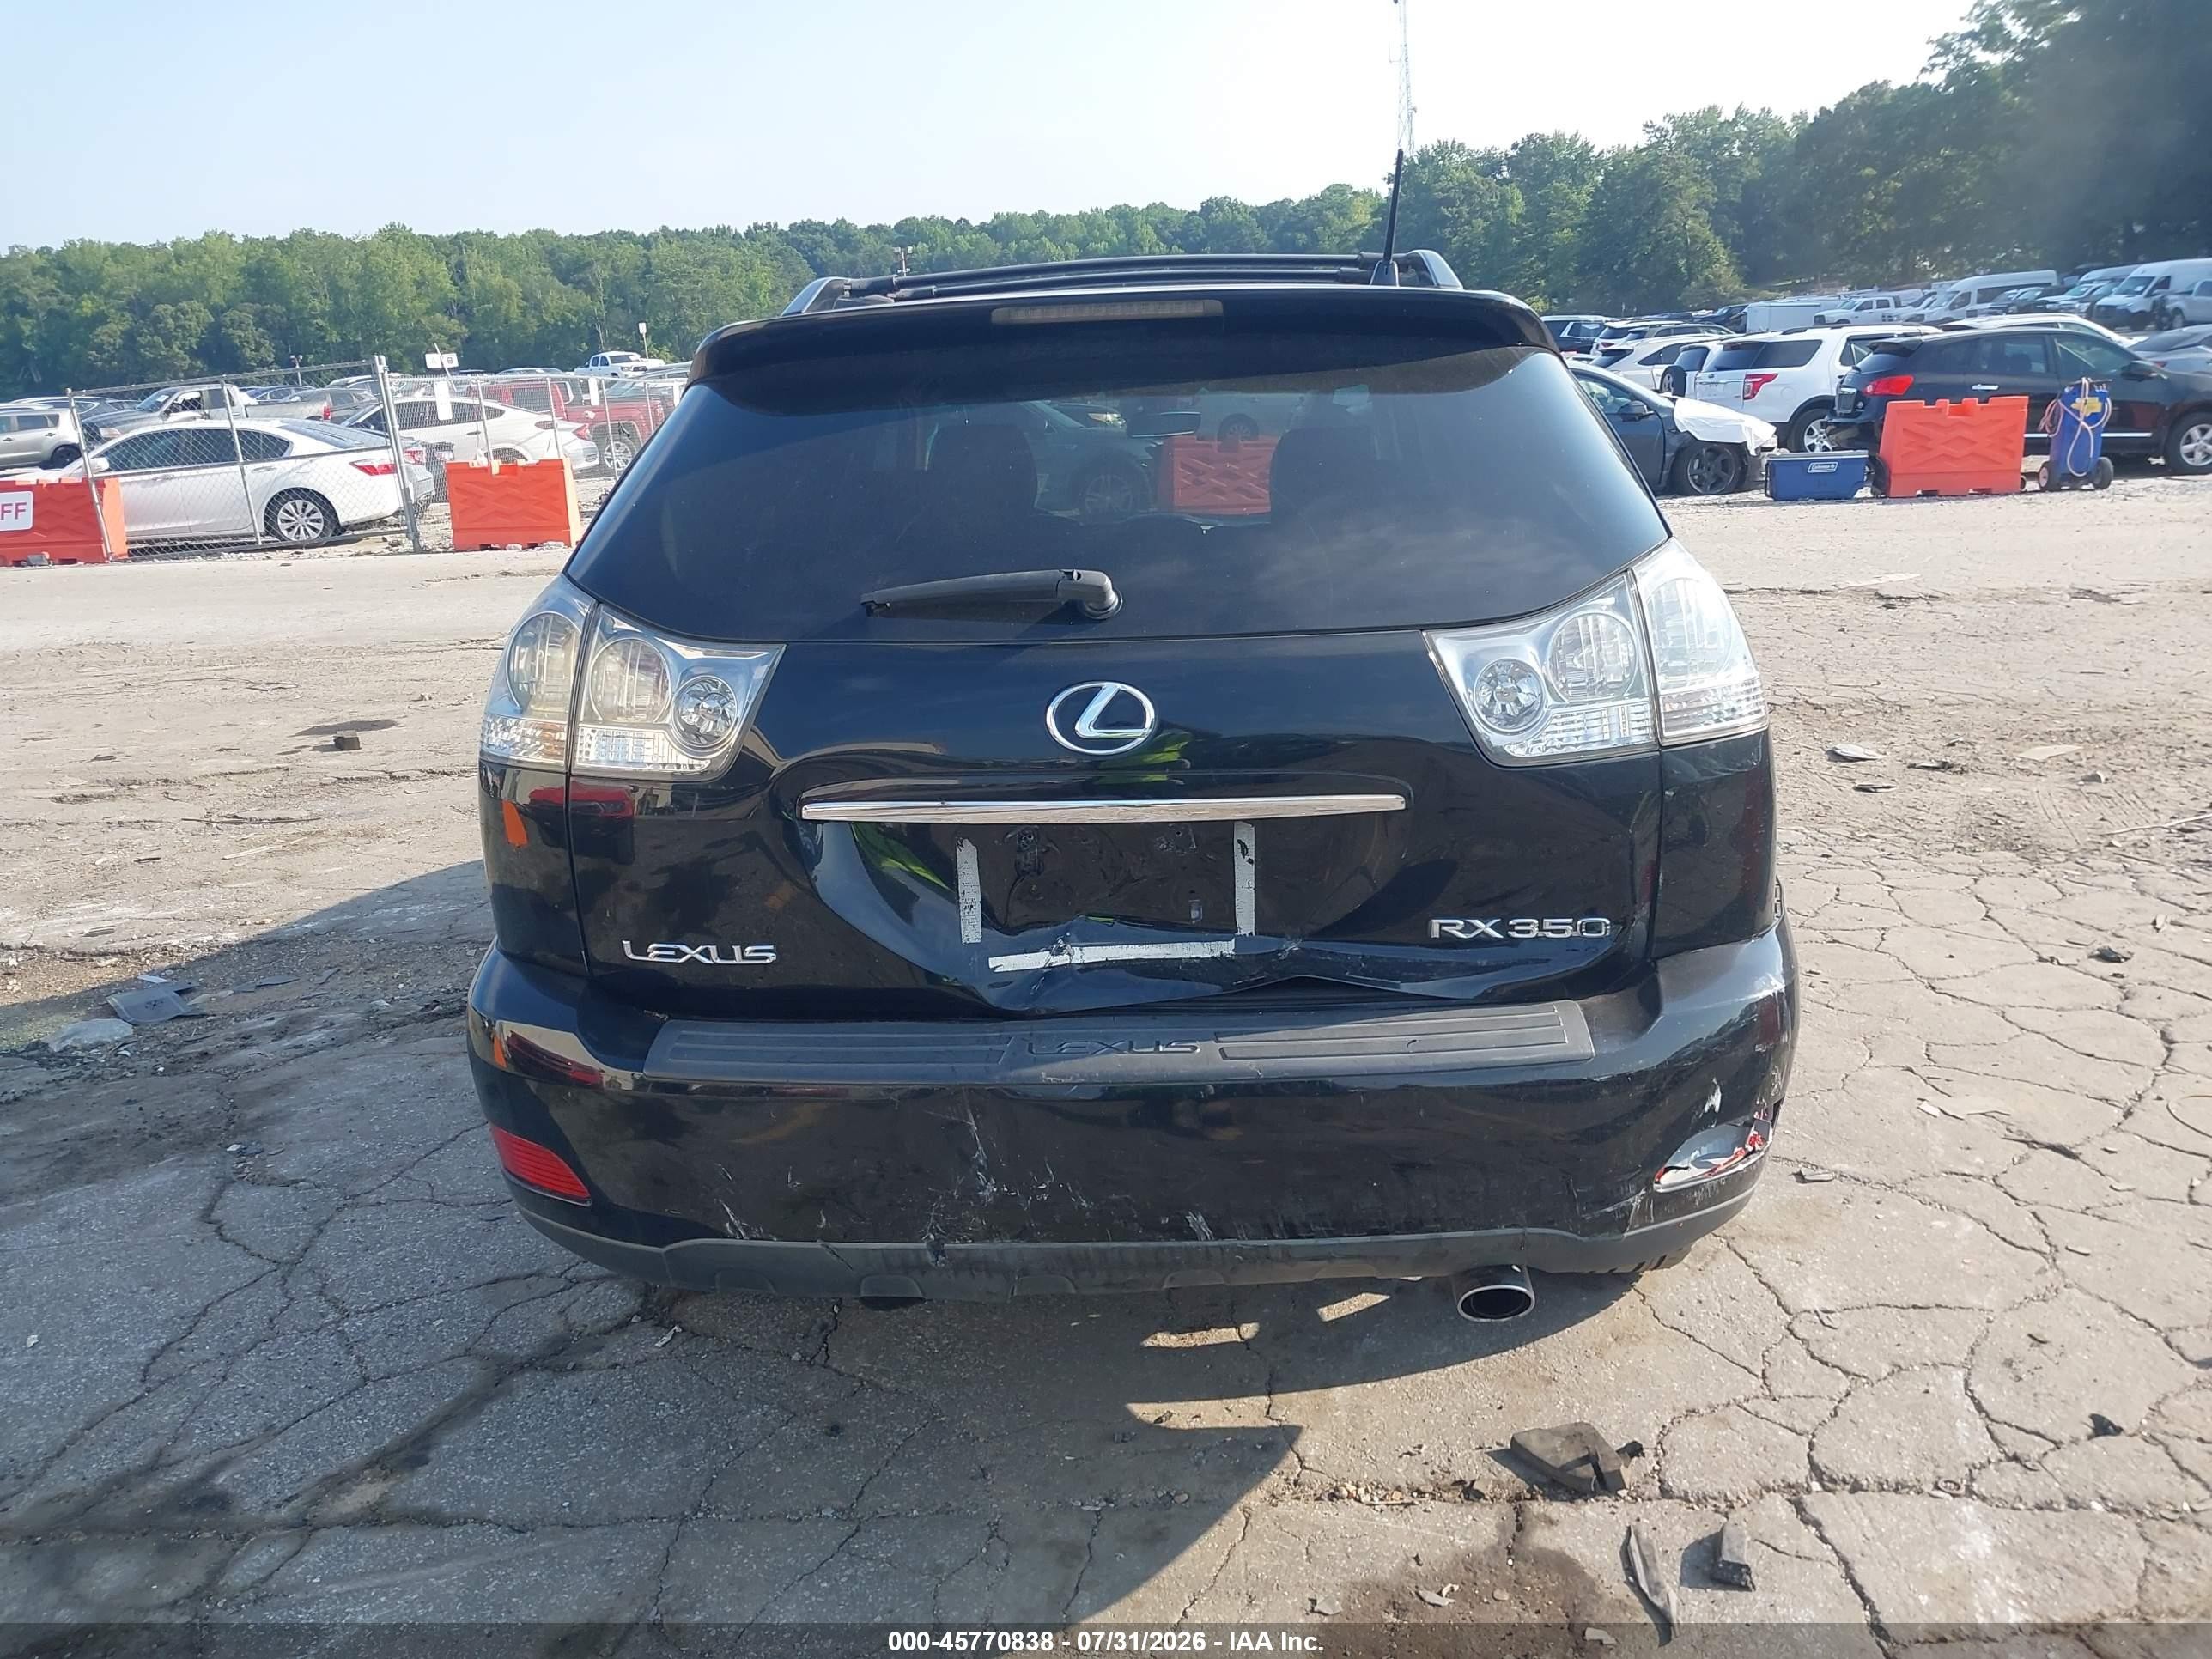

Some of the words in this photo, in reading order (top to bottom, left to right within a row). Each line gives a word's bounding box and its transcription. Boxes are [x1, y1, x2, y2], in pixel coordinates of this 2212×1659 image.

[1, 502, 27, 520] FF
[622, 940, 777, 964] LEXUS
[1027, 1040, 1201, 1055] LEXUS
